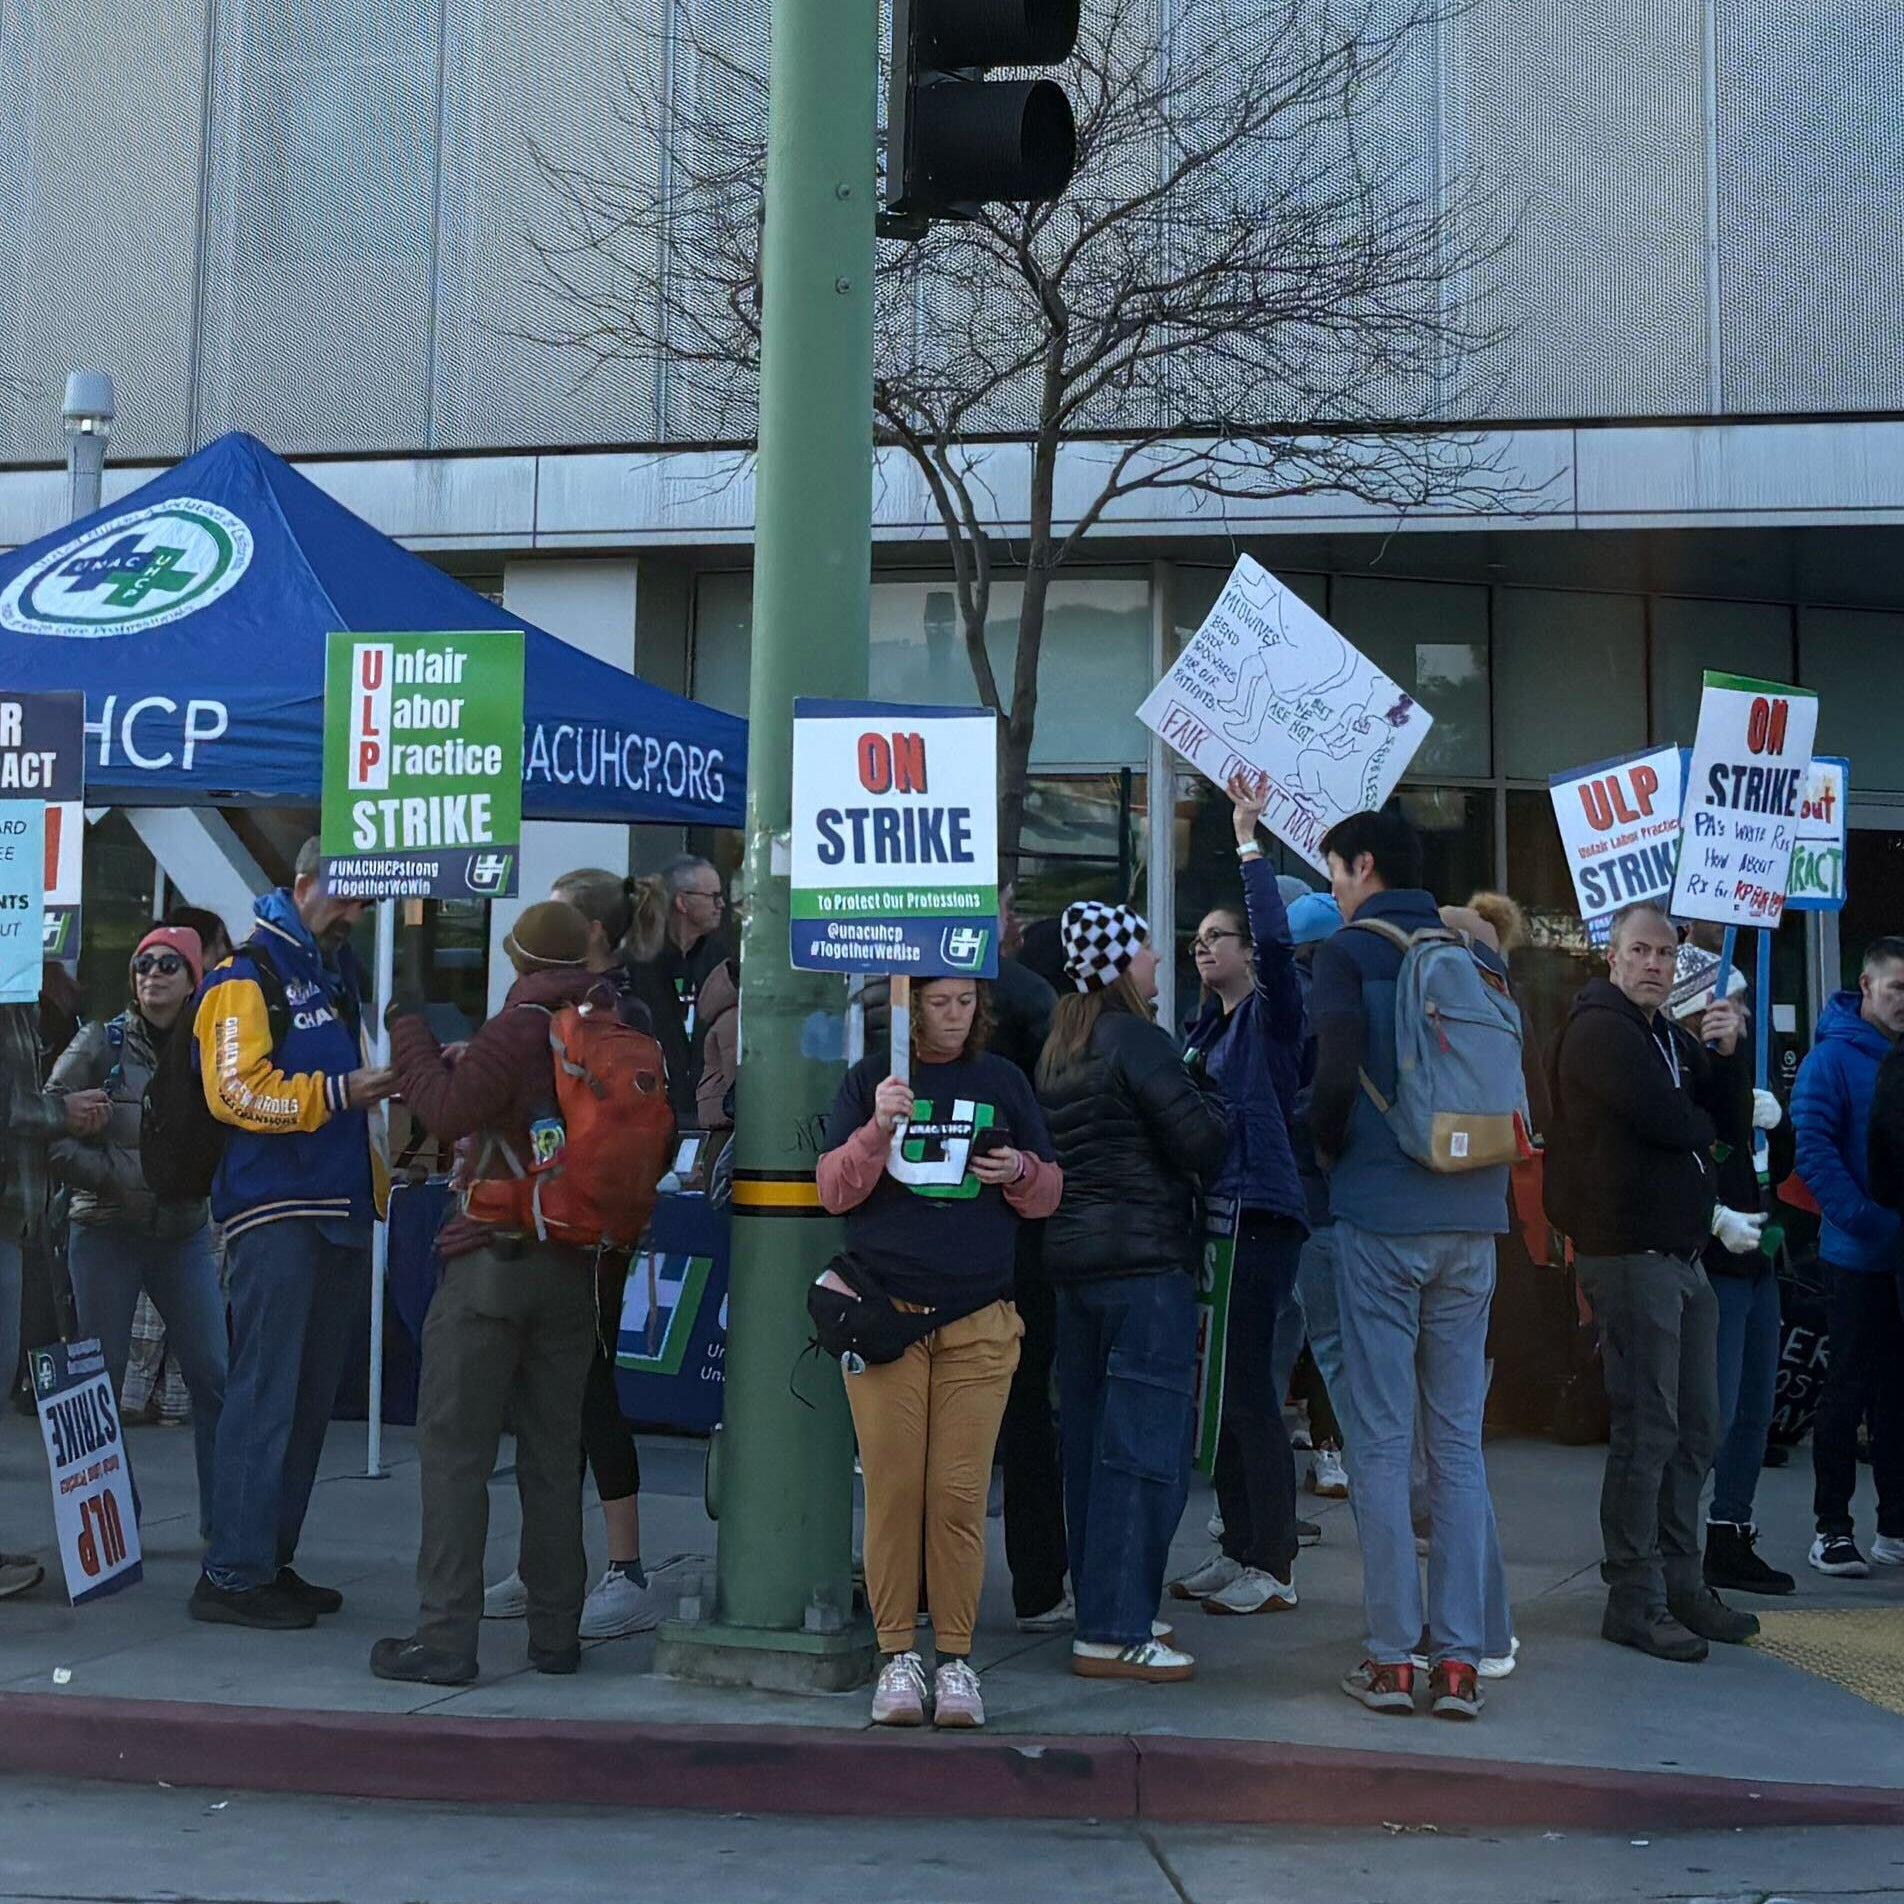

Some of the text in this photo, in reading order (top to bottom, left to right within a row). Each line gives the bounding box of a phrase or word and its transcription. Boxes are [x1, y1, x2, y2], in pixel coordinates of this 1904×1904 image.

[74, 556, 140, 572] UNAC
[122, 554, 171, 599] UHCP
[1221, 590, 1281, 647] MIDWIVES
[1162, 707, 1210, 760] FAIR
[1747, 697, 1789, 756] ON
[521, 724, 726, 803] ACUHCP.ORG
[857, 733, 928, 795] ON
[1705, 763, 1800, 817] STRIKE
[353, 794, 492, 850] STRIKE
[1578, 765, 1659, 831] ULP
[816, 807, 975, 865] STRIKE
[818, 893, 980, 911] To Protect Our Professions
[828, 923, 903, 943] @unacuhcp
[46, 1383, 117, 1468] STRIKE
[78, 1489, 126, 1577] ULP
